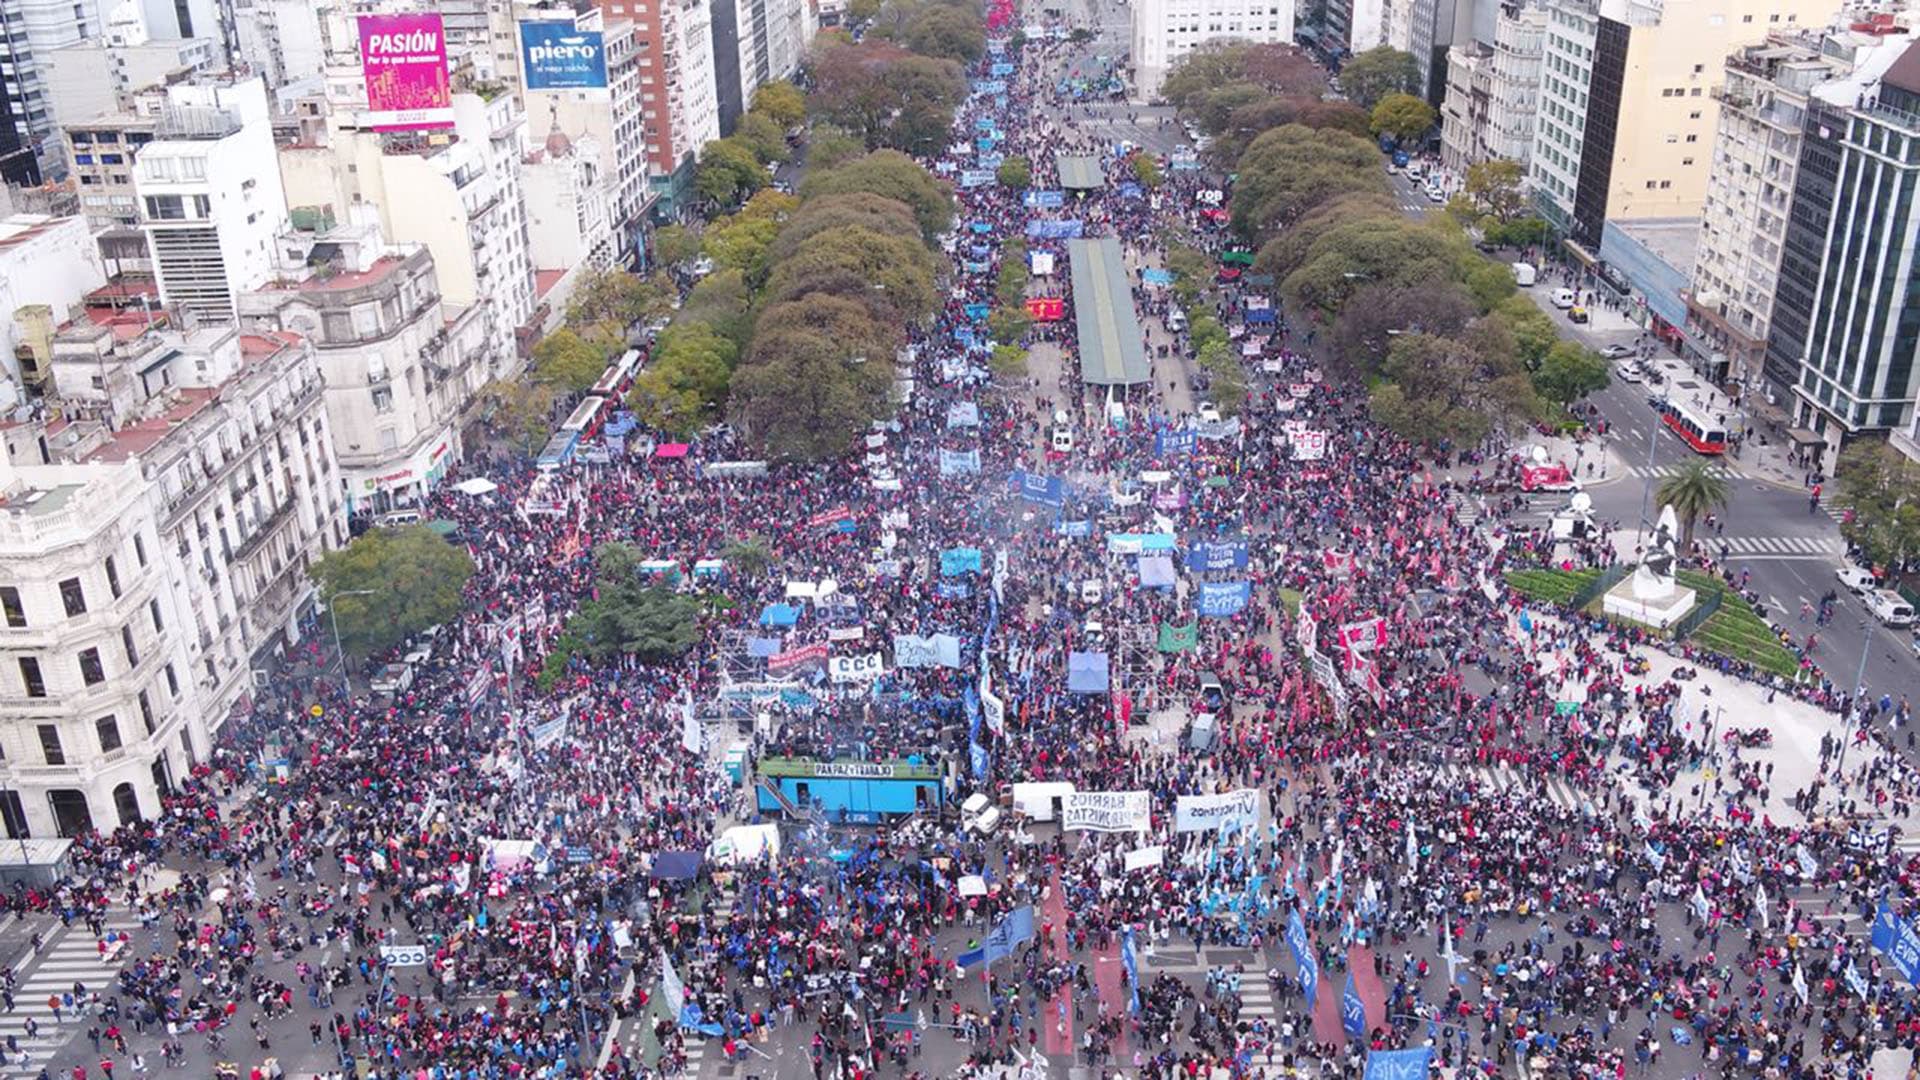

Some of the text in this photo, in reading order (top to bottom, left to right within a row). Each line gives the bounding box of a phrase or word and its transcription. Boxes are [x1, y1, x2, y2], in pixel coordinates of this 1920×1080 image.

[369, 29, 437, 54] PASIÓN
[529, 39, 595, 64] piero
[839, 656, 876, 671] CCC
